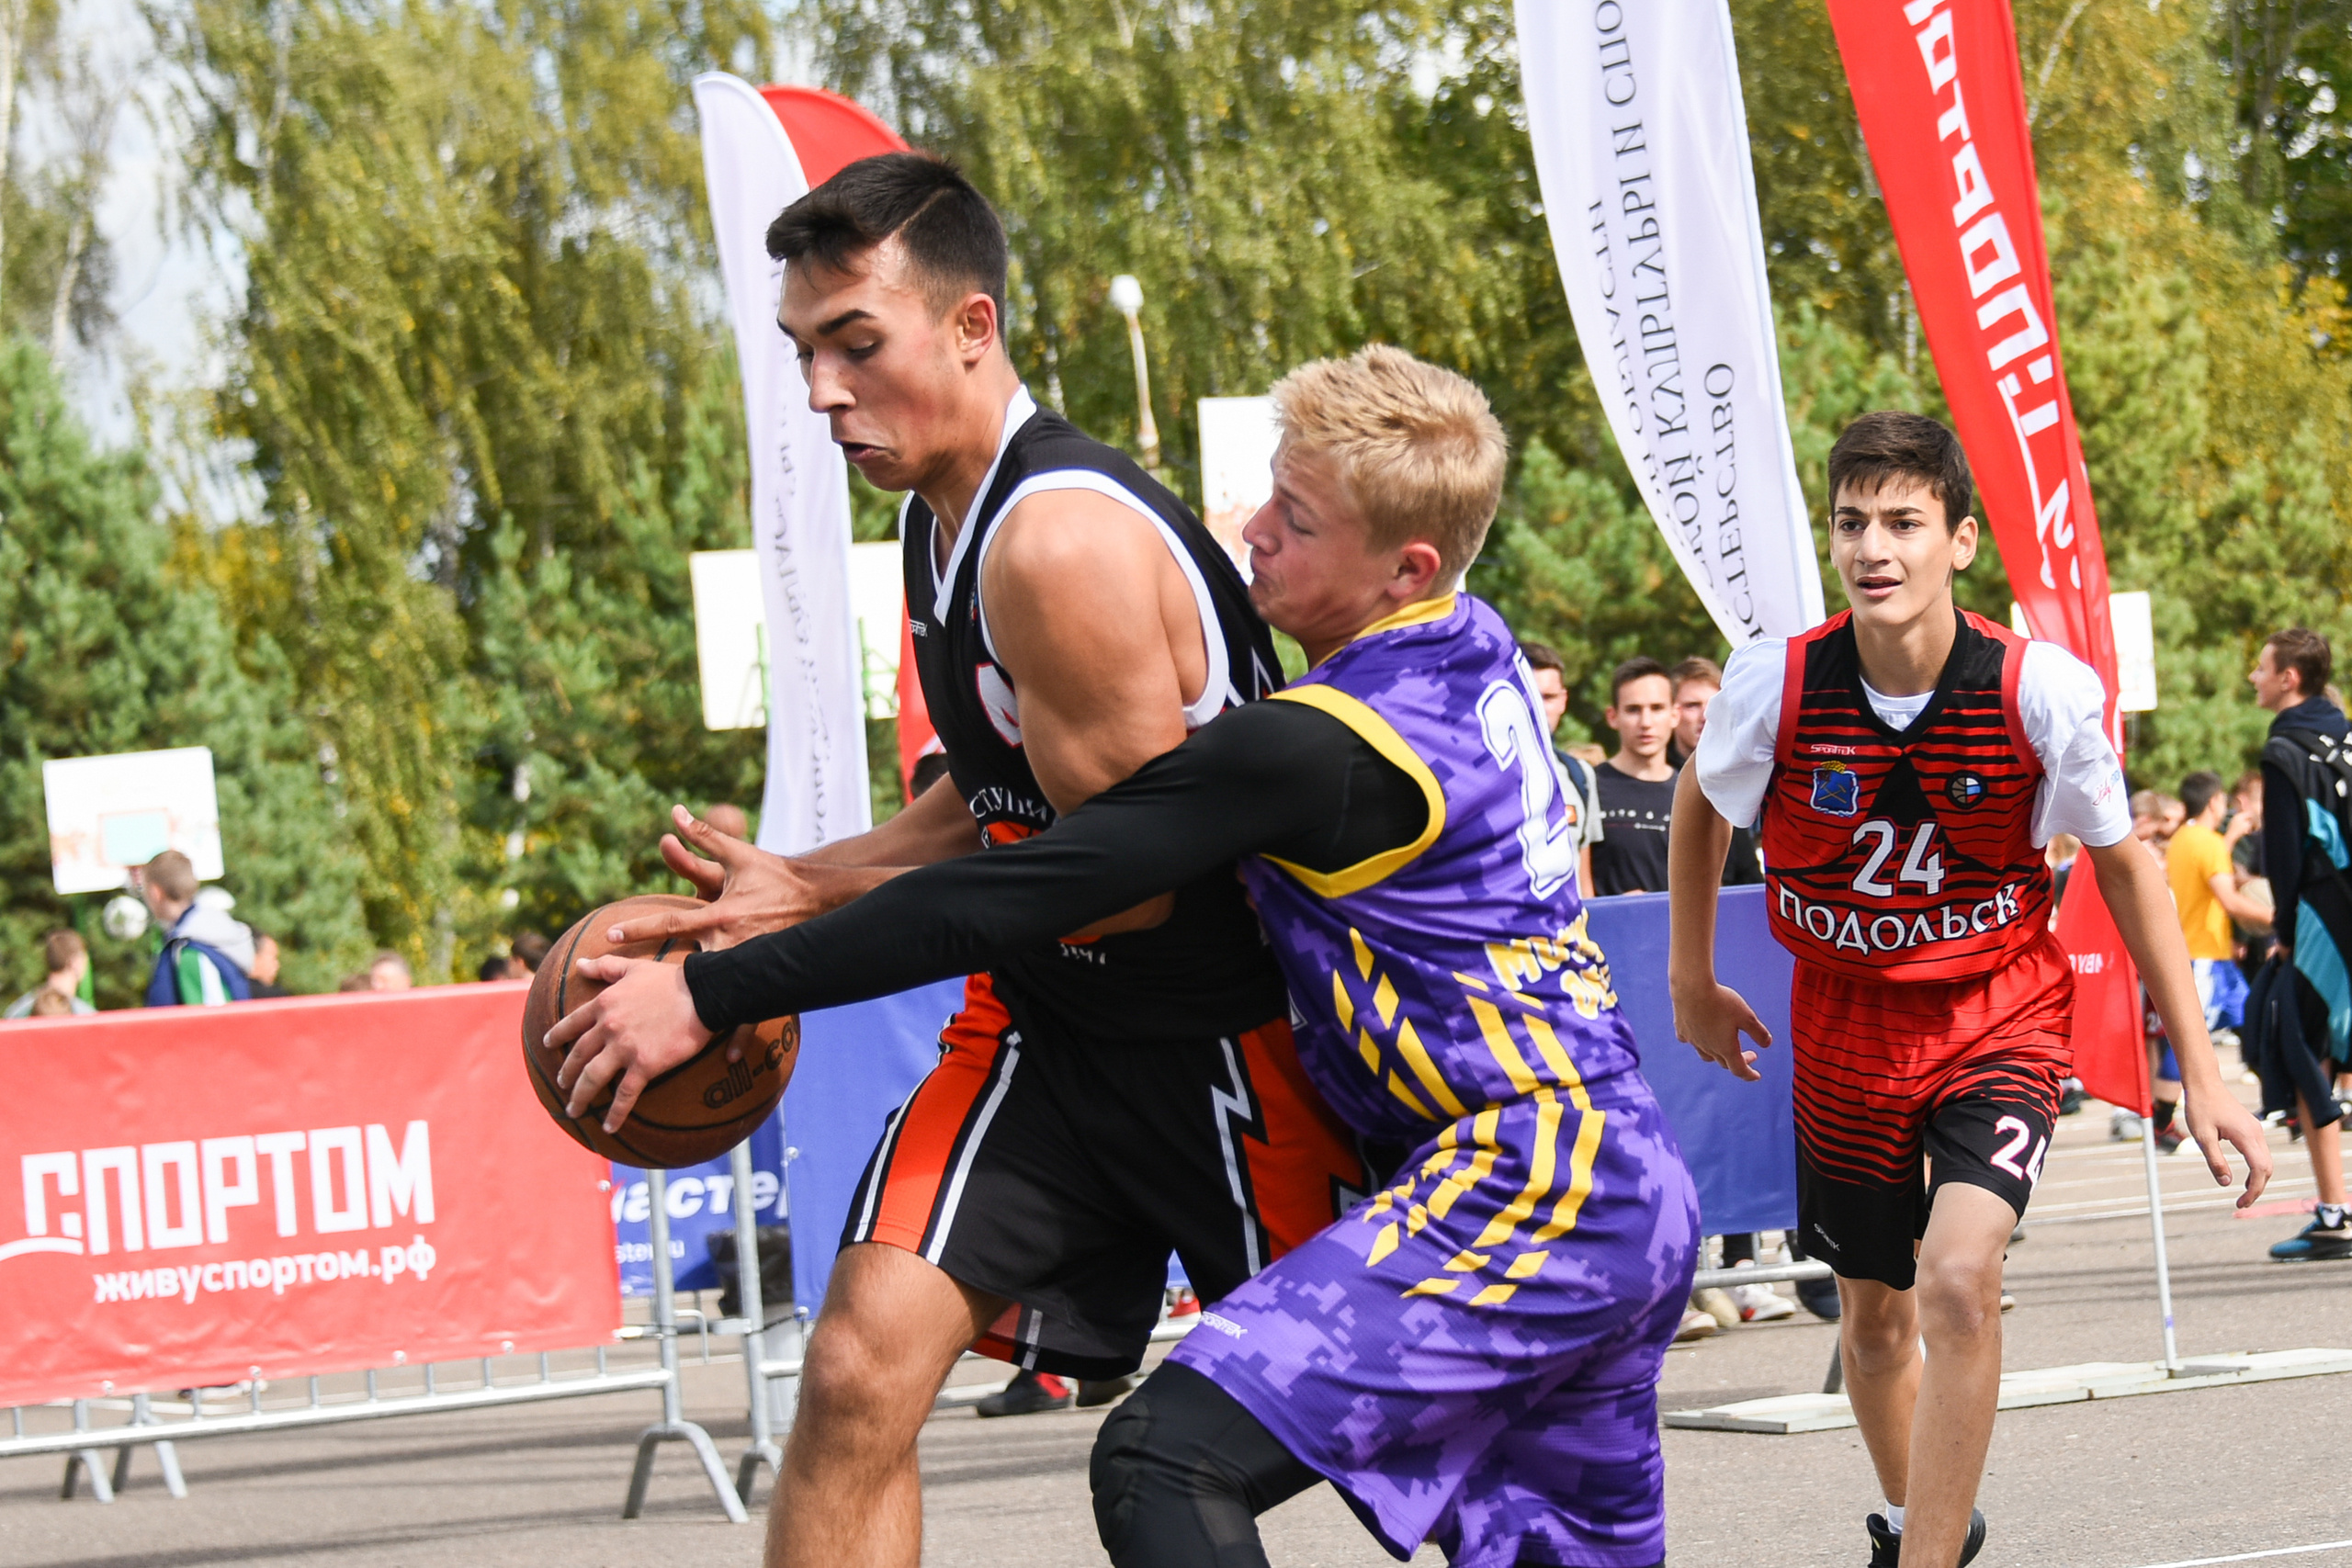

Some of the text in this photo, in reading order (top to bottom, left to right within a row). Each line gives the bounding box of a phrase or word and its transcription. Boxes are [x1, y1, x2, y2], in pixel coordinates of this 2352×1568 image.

[1852, 819, 1946, 897] 24
[1779, 883, 2020, 956] ПОДОЛЬСК
[20, 1119, 435, 1256] СПОРТОМ
[92, 1235, 437, 1304] живуспортом.рф
